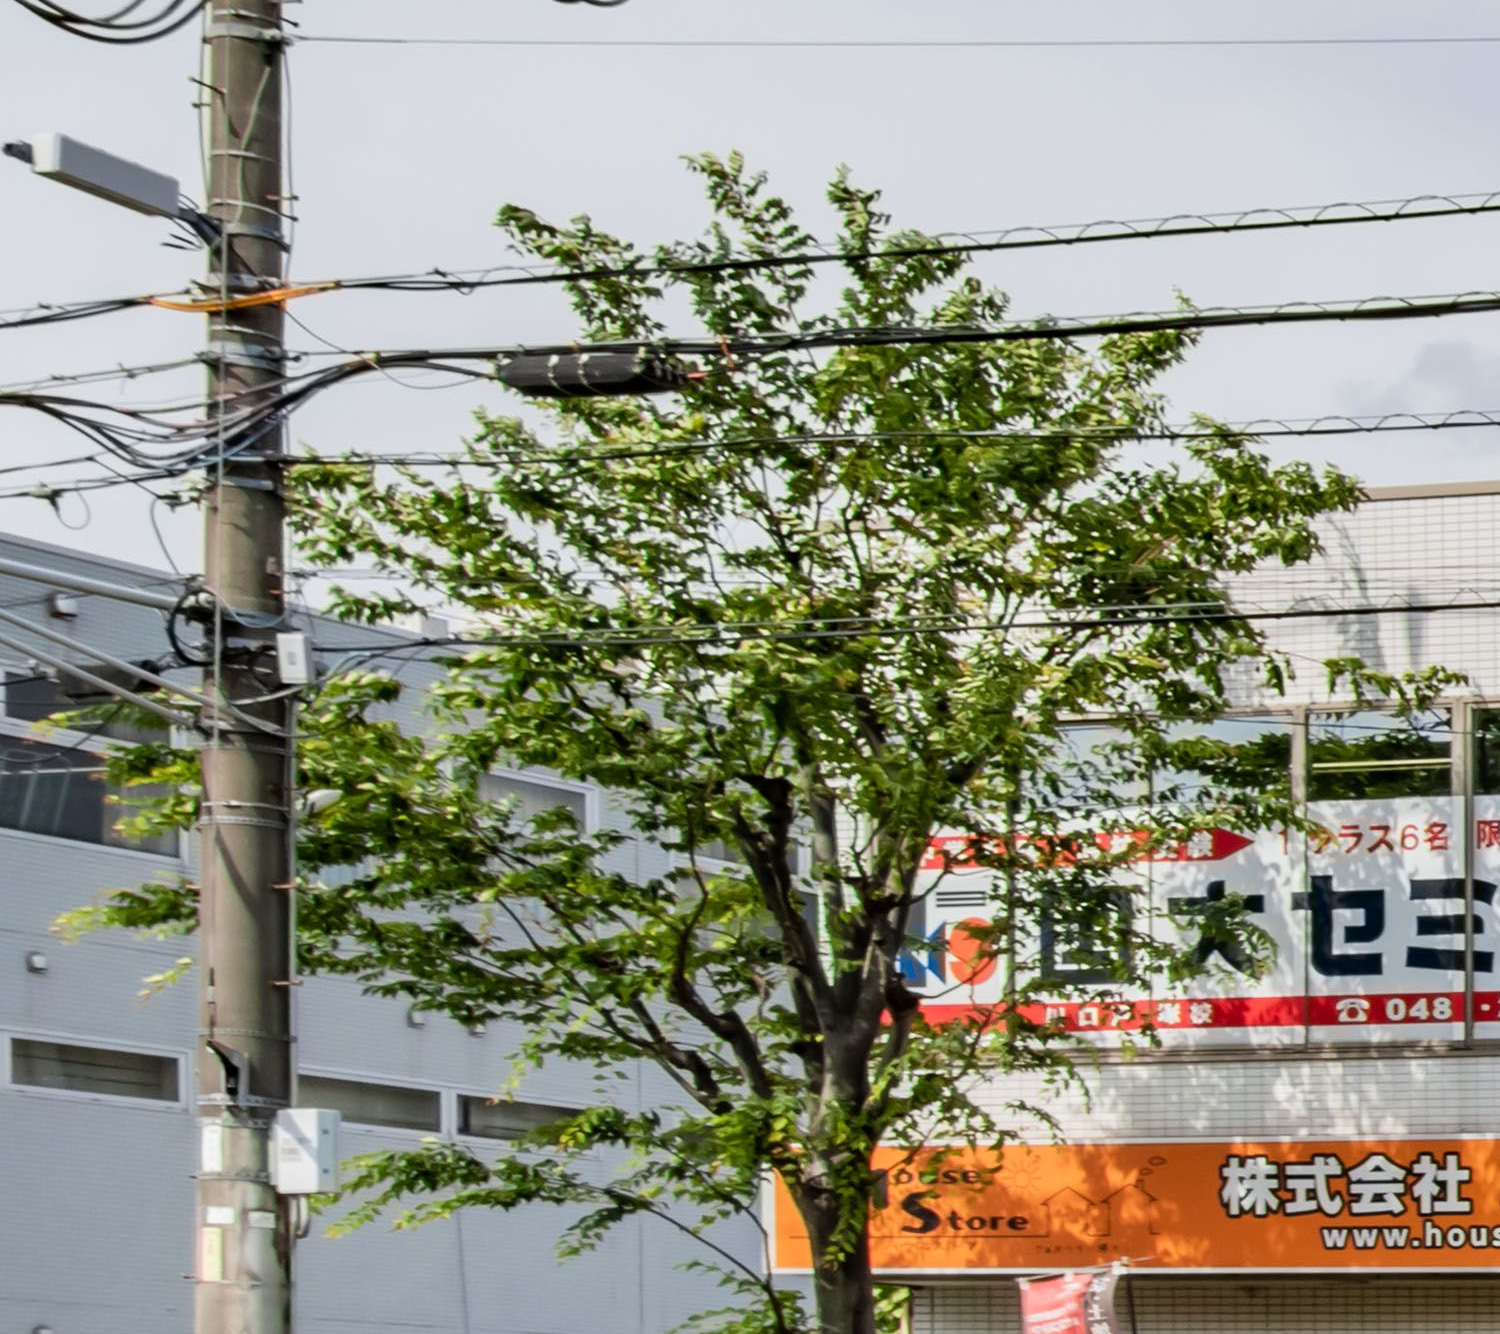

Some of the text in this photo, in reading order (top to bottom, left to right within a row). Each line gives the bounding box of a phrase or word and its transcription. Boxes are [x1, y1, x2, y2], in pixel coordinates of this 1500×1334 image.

[1220, 1153, 1471, 1217] 株式会社
[901, 1191, 1029, 1234] Store
